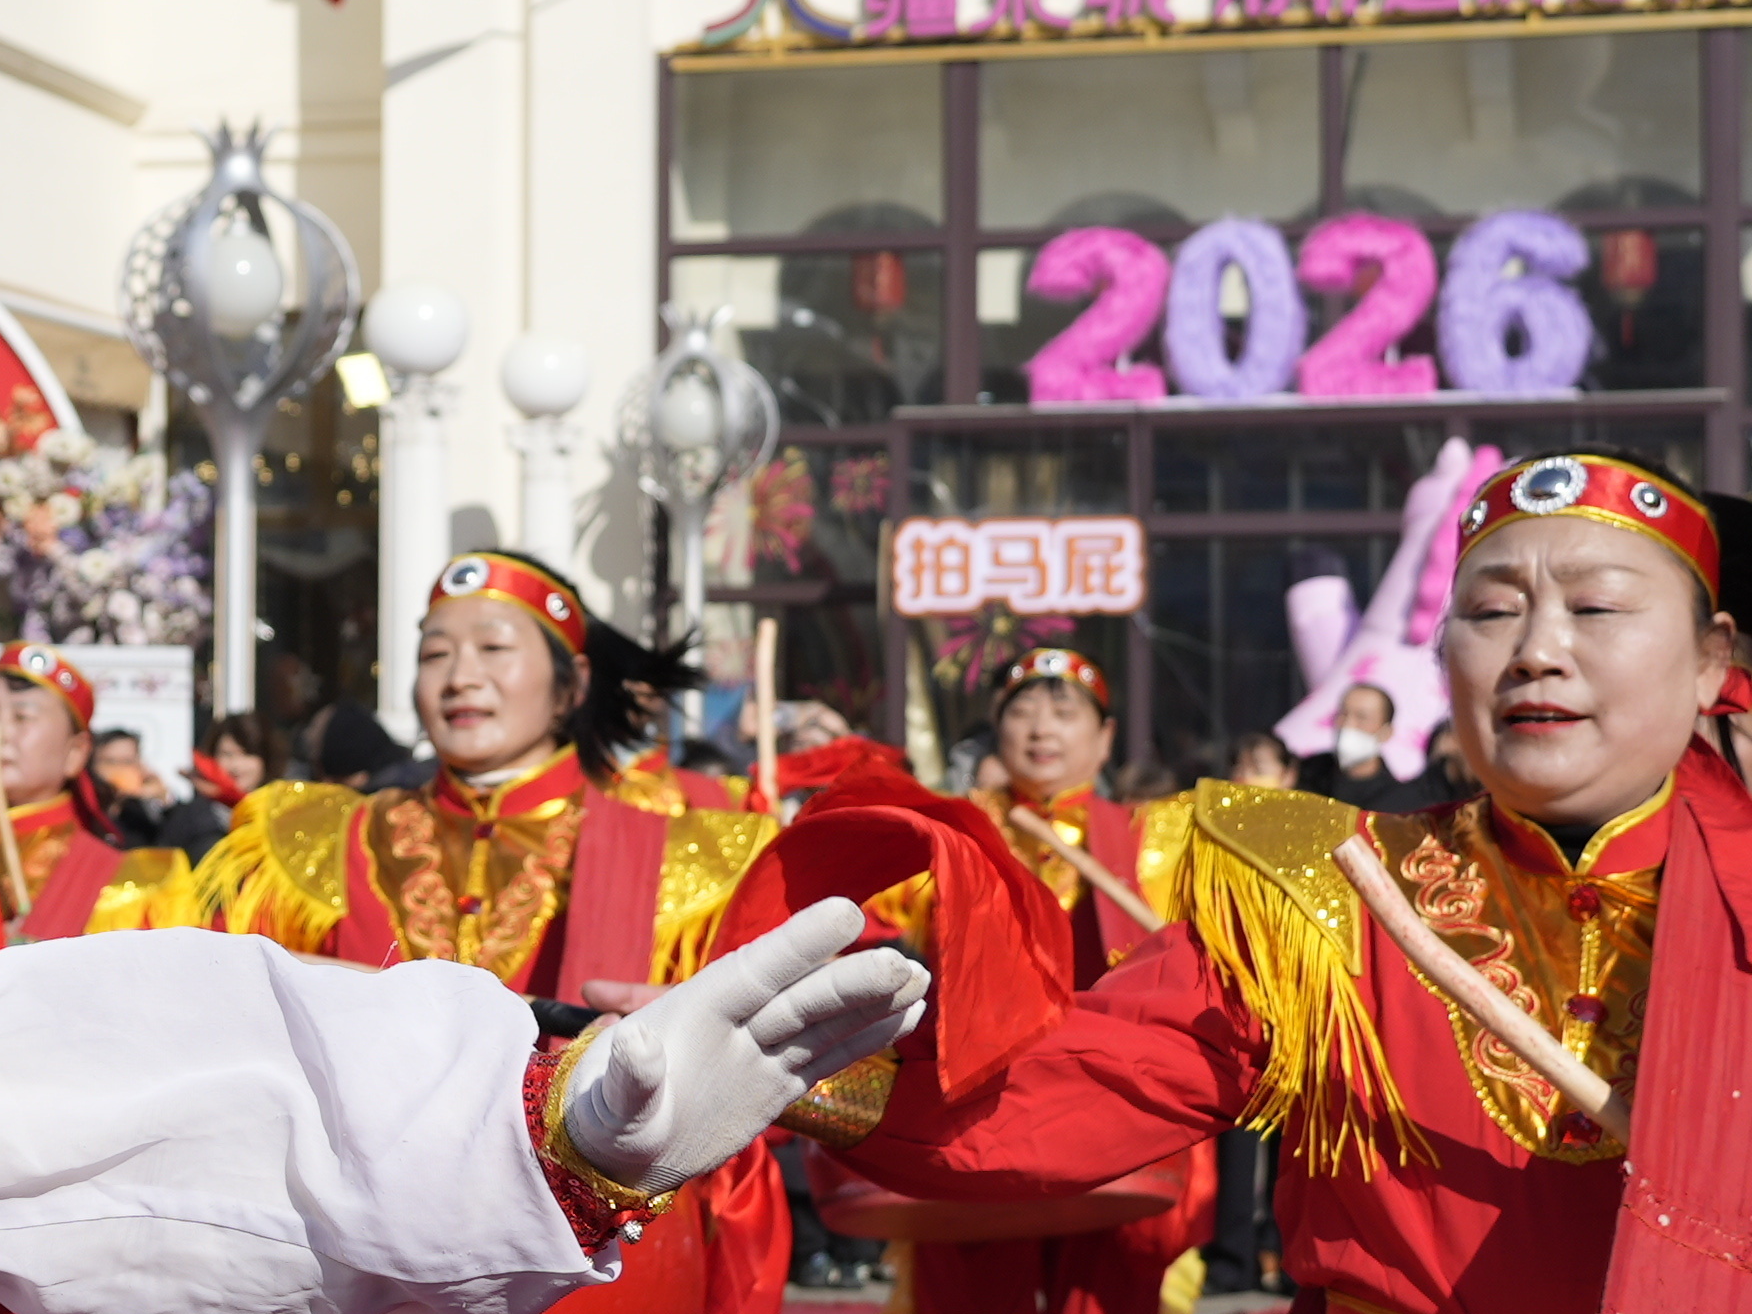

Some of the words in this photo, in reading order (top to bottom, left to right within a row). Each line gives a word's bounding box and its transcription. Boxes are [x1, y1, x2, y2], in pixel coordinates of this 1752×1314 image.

[1025, 209, 1596, 403] 2026
[902, 527, 1135, 607] 拍马屁
